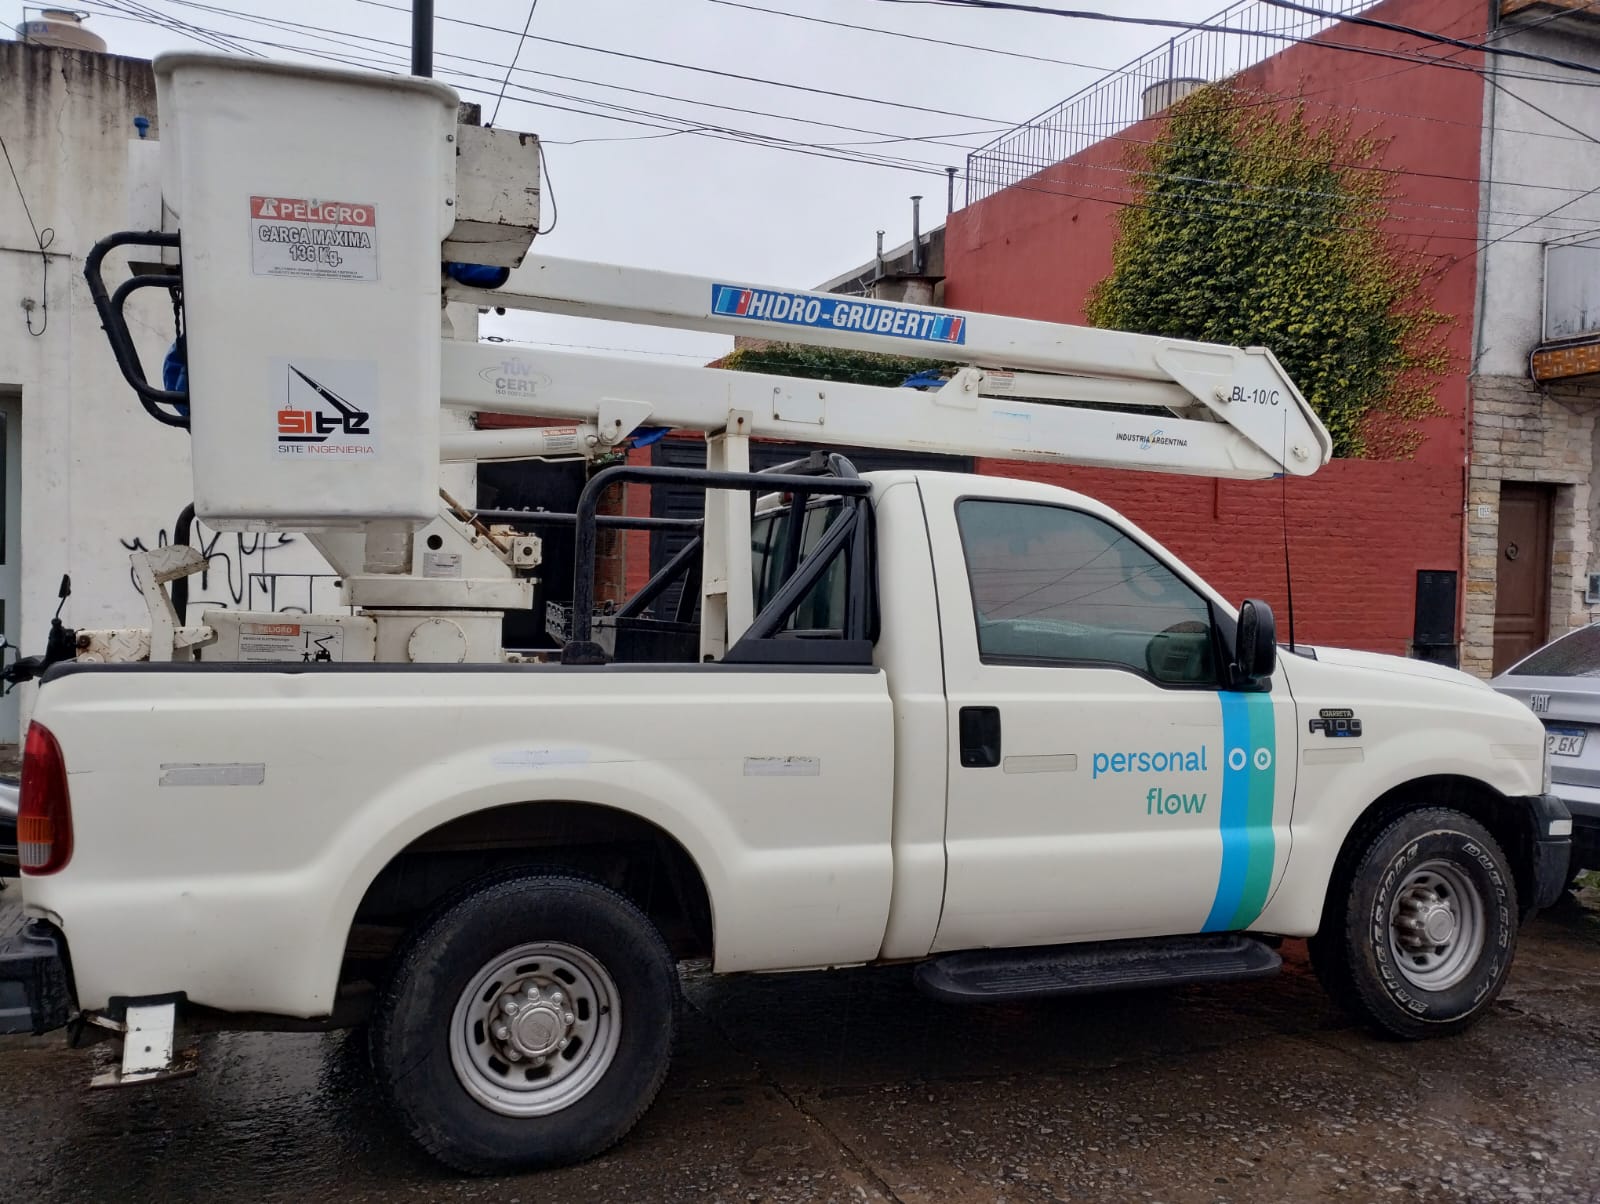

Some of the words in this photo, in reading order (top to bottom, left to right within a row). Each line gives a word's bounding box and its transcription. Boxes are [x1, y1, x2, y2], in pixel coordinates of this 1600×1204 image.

[281, 203, 367, 223] PELIGRO
[259, 226, 310, 244] CARGA
[313, 229, 371, 249] MAXIMA
[290, 245, 316, 262] 136
[319, 247, 343, 267] Kg.
[747, 289, 936, 337] HIDRO-GRUBERT
[495, 377, 538, 393] CERT
[1232, 386, 1280, 406] BL-10/C
[278, 445, 304, 453] SITE
[308, 445, 375, 454] INGENIERIA
[1116, 433, 1151, 443] INDUSTRIA
[1152, 437, 1188, 447] ARGENTINA
[1530, 695, 1551, 712] FIAT
[1558, 737, 1579, 752] GK
[1093, 745, 1207, 780] personal
[1146, 787, 1207, 815] flow
